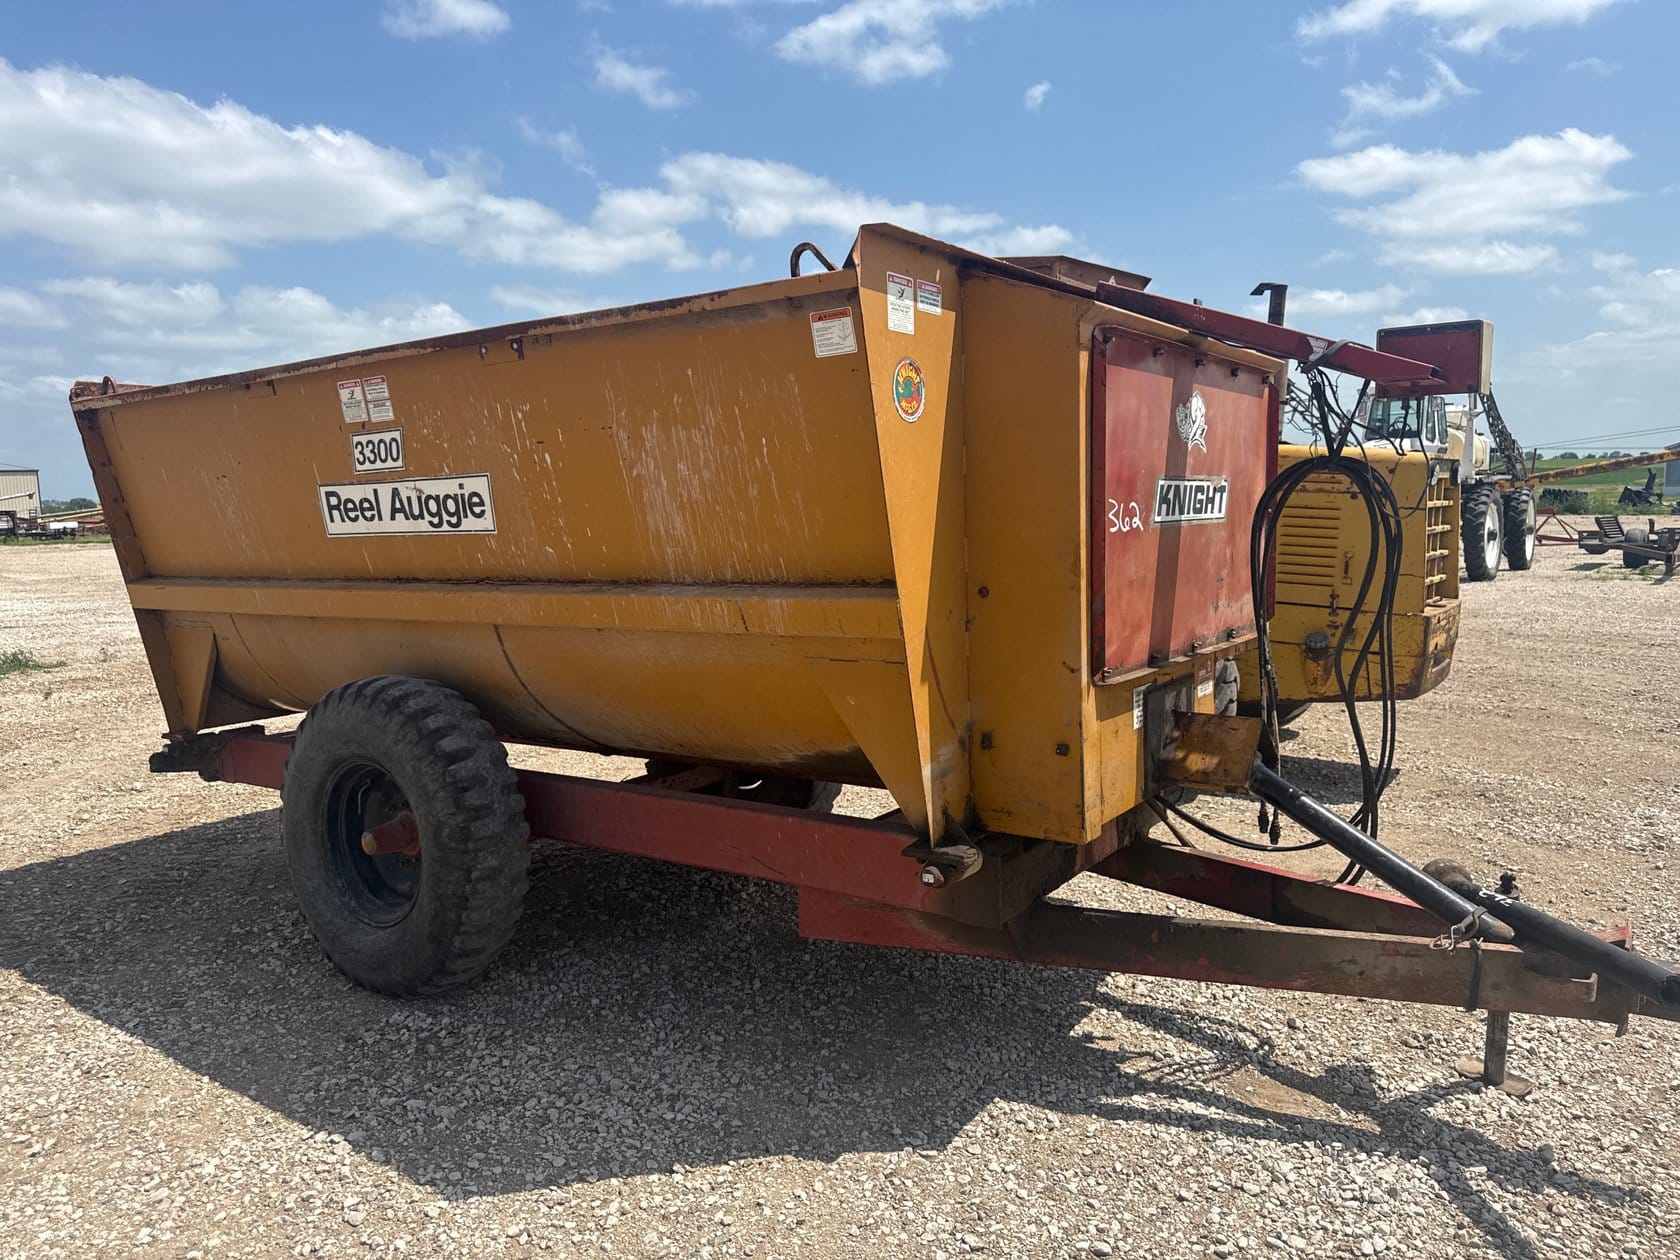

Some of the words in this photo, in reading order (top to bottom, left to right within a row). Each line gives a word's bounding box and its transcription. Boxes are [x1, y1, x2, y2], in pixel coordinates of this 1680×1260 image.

[823, 309, 849, 319] WARNING
[898, 364, 921, 385] KNIGHT
[354, 437, 401, 466] 3300
[324, 488, 384, 524] Reel
[390, 482, 486, 529] Auggie
[1108, 498, 1144, 533] 362
[1156, 484, 1227, 517] KNIGHT
